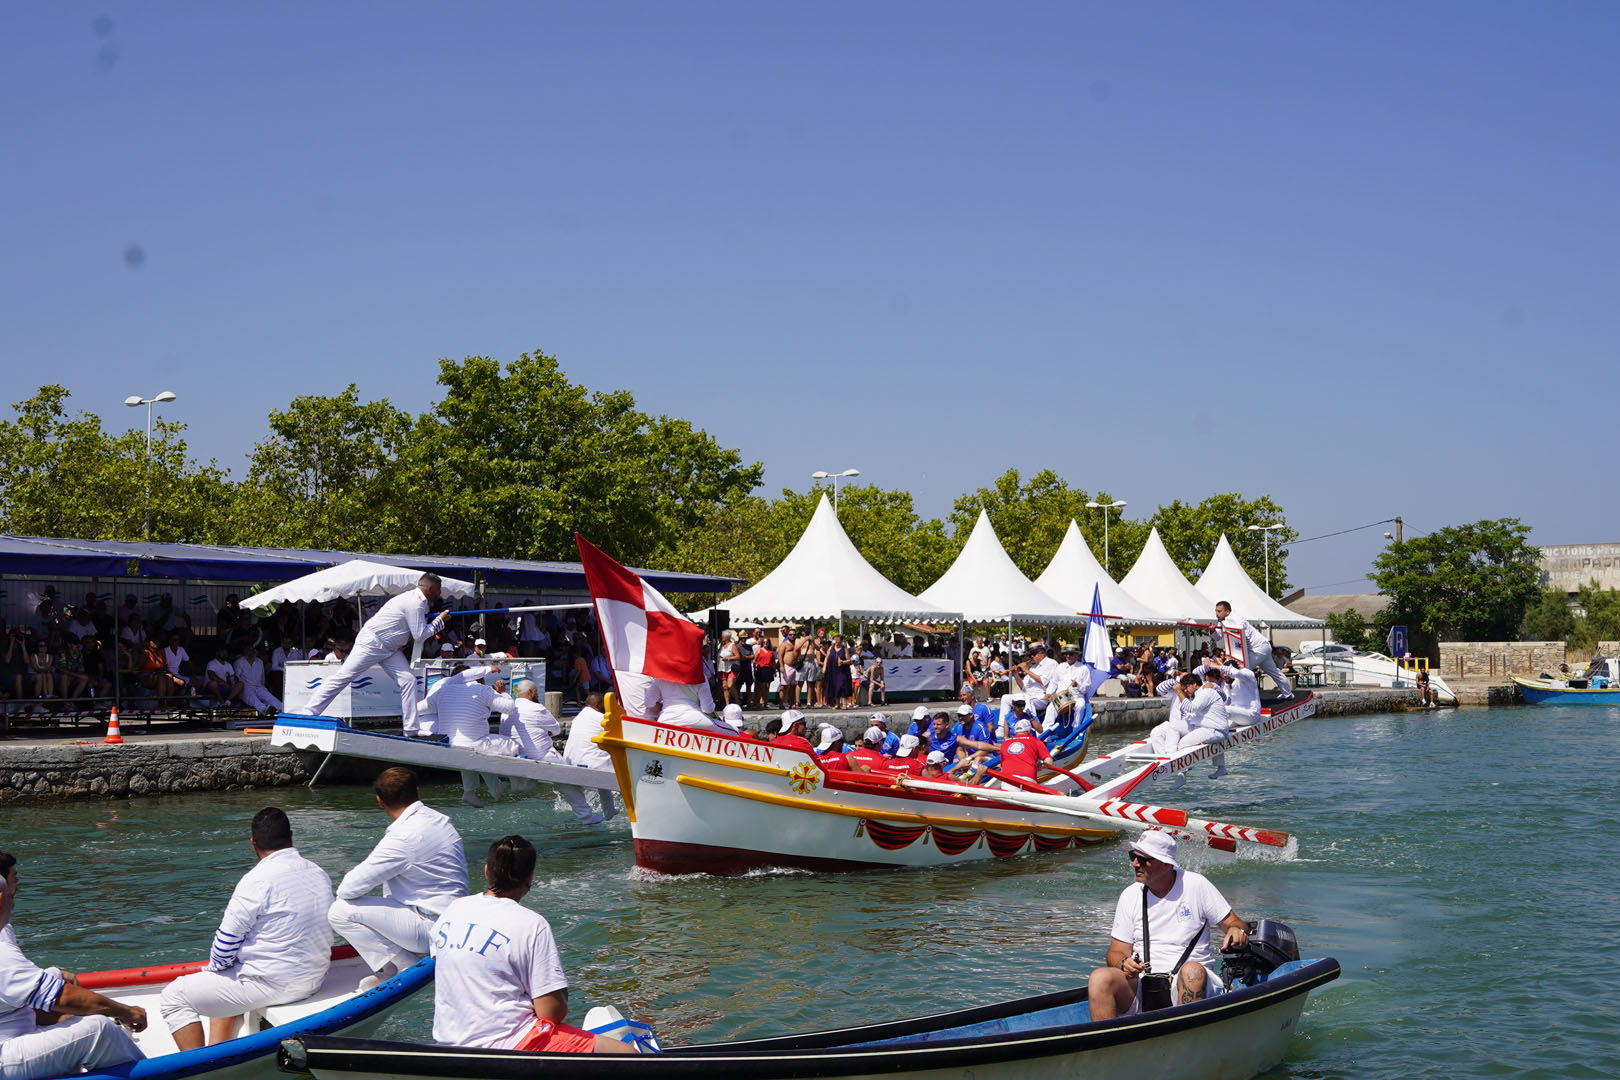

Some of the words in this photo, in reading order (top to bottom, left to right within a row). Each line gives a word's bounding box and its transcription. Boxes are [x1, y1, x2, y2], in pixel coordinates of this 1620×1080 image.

[653, 728, 775, 763] FRONTIGNAN
[1170, 734, 1239, 773] FRONTIGNAN
[1241, 723, 1261, 743] SON
[1263, 708, 1300, 732] MUSCAT
[438, 921, 511, 957] S.J.F
